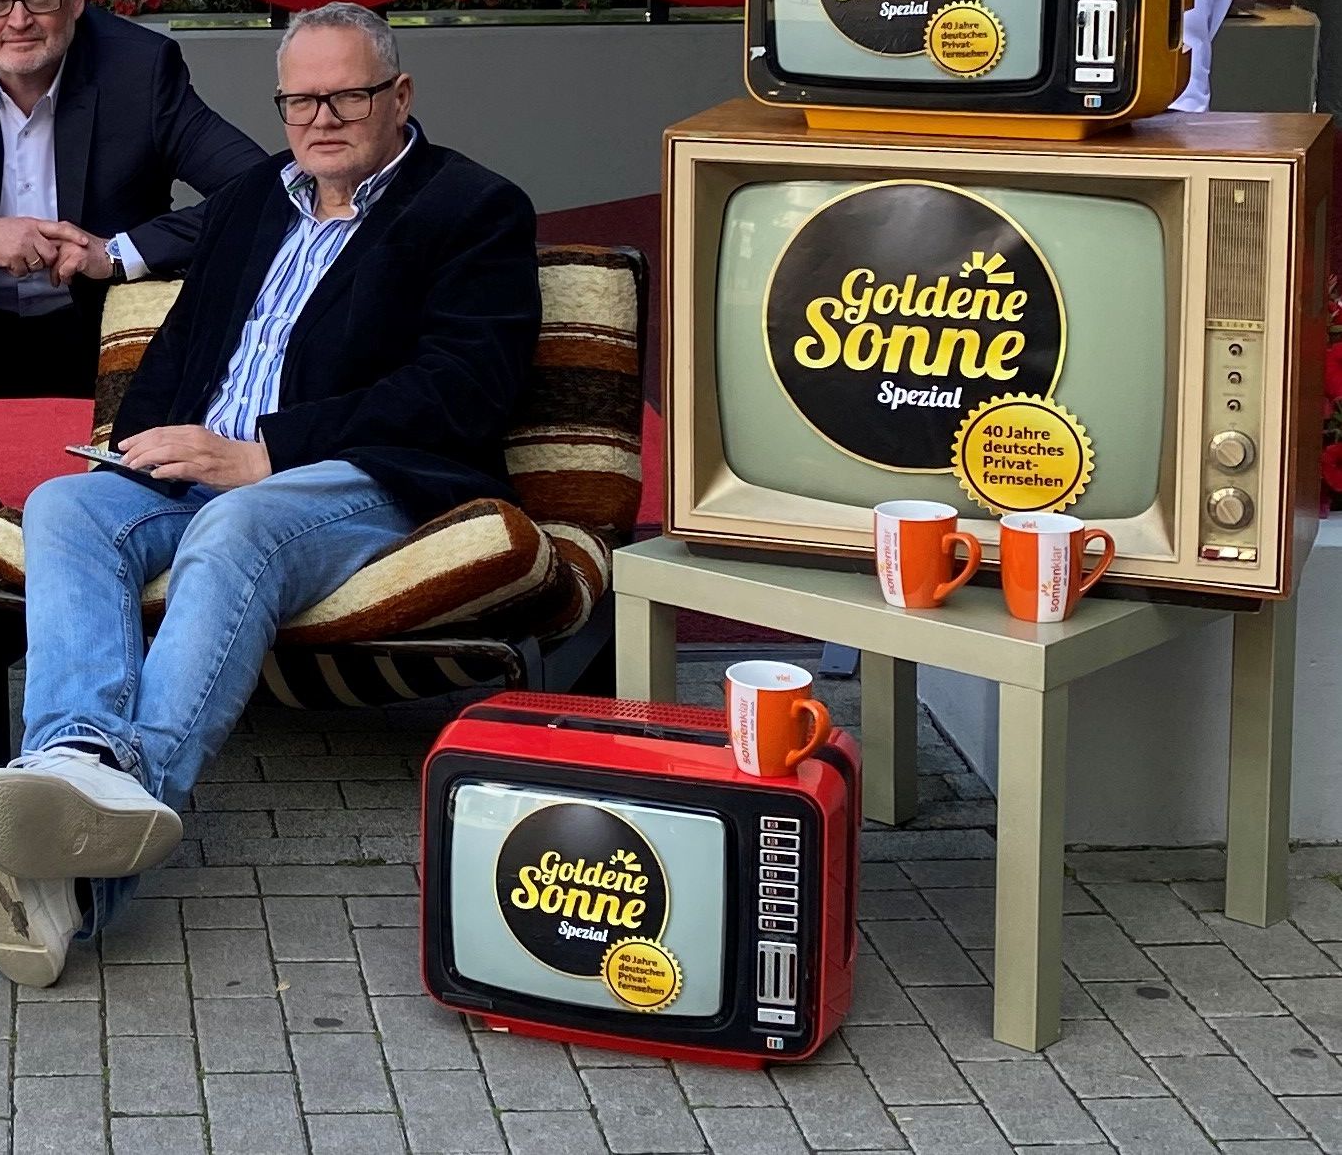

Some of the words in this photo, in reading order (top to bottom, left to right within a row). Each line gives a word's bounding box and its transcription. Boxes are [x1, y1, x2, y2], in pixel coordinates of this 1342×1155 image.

[879, 0, 929, 21] Spezial
[941, 22, 953, 31] 40
[954, 21, 980, 31] Jahre
[941, 31, 988, 40] deutsches
[841, 267, 1028, 325] Goldene
[794, 296, 1026, 381] Sonne
[876, 380, 962, 410] Spezial
[982, 425, 1004, 439] 40
[1006, 426, 1051, 442] Jahre
[982, 440, 1065, 458] deutsches
[982, 456, 1039, 471] Privat-
[982, 471, 1064, 489] fernsehen
[539, 851, 648, 895] Goldene
[510, 864, 647, 929] Sonne
[558, 920, 608, 943] Spezial
[618, 953, 630, 963] 40
[631, 956, 658, 967] Jahre
[618, 963, 666, 977] deutsches
